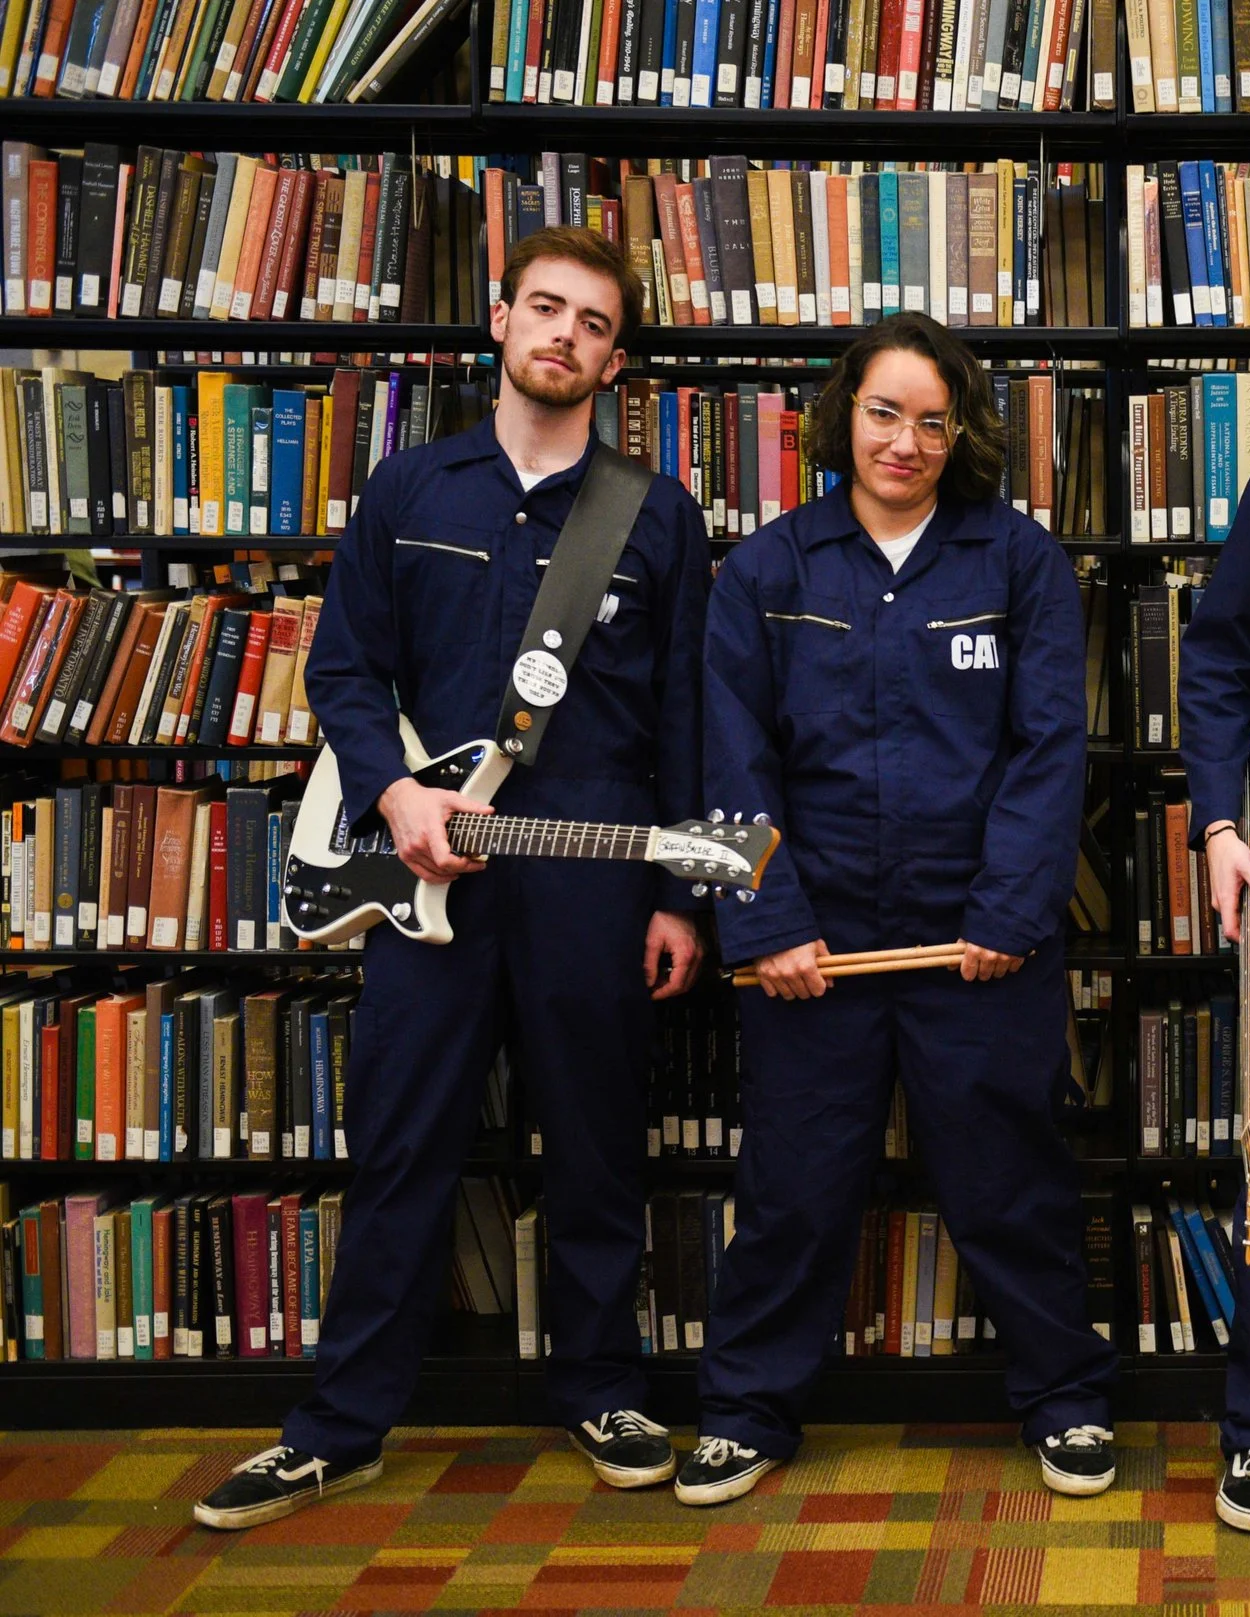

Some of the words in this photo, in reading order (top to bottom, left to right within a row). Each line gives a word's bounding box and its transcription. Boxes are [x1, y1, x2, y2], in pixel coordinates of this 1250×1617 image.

[939, 0, 956, 59] MINGWAY
[281, 177, 292, 192] THE
[317, 179, 327, 201] THE
[272, 193, 289, 229] GHOSTLY
[312, 201, 324, 233] SIMPLE
[135, 232, 151, 284] HAMMETT
[308, 234, 319, 268] TRUTH
[707, 246, 721, 282] BLUES
[157, 396, 165, 425] MISTER
[1179, 391, 1187, 423] LAURA
[34, 411, 42, 440] ERNEST
[628, 397, 641, 456] HIMES
[157, 428, 165, 463] ROBERTS
[1180, 425, 1188, 460] RIDING
[190, 459, 198, 486] Heinlein
[816, 471, 824, 497] CHESTER
[180, 624, 199, 665] Hemingway's
[171, 684, 183, 697] War
[176, 666, 186, 683] First
[219, 1055, 227, 1080] ERNEST
[219, 1082, 227, 1123] HEMINGWAY
[315, 1060, 325, 1114] HEMINGWAY
[211, 1217, 223, 1279] HEMINGWAY
[286, 1217, 296, 1248] FAME
[303, 1230, 314, 1264] PAPA
[286, 1250, 297, 1294] BECAME
[287, 1295, 298, 1309] OF
[288, 1311, 298, 1332] HIM
